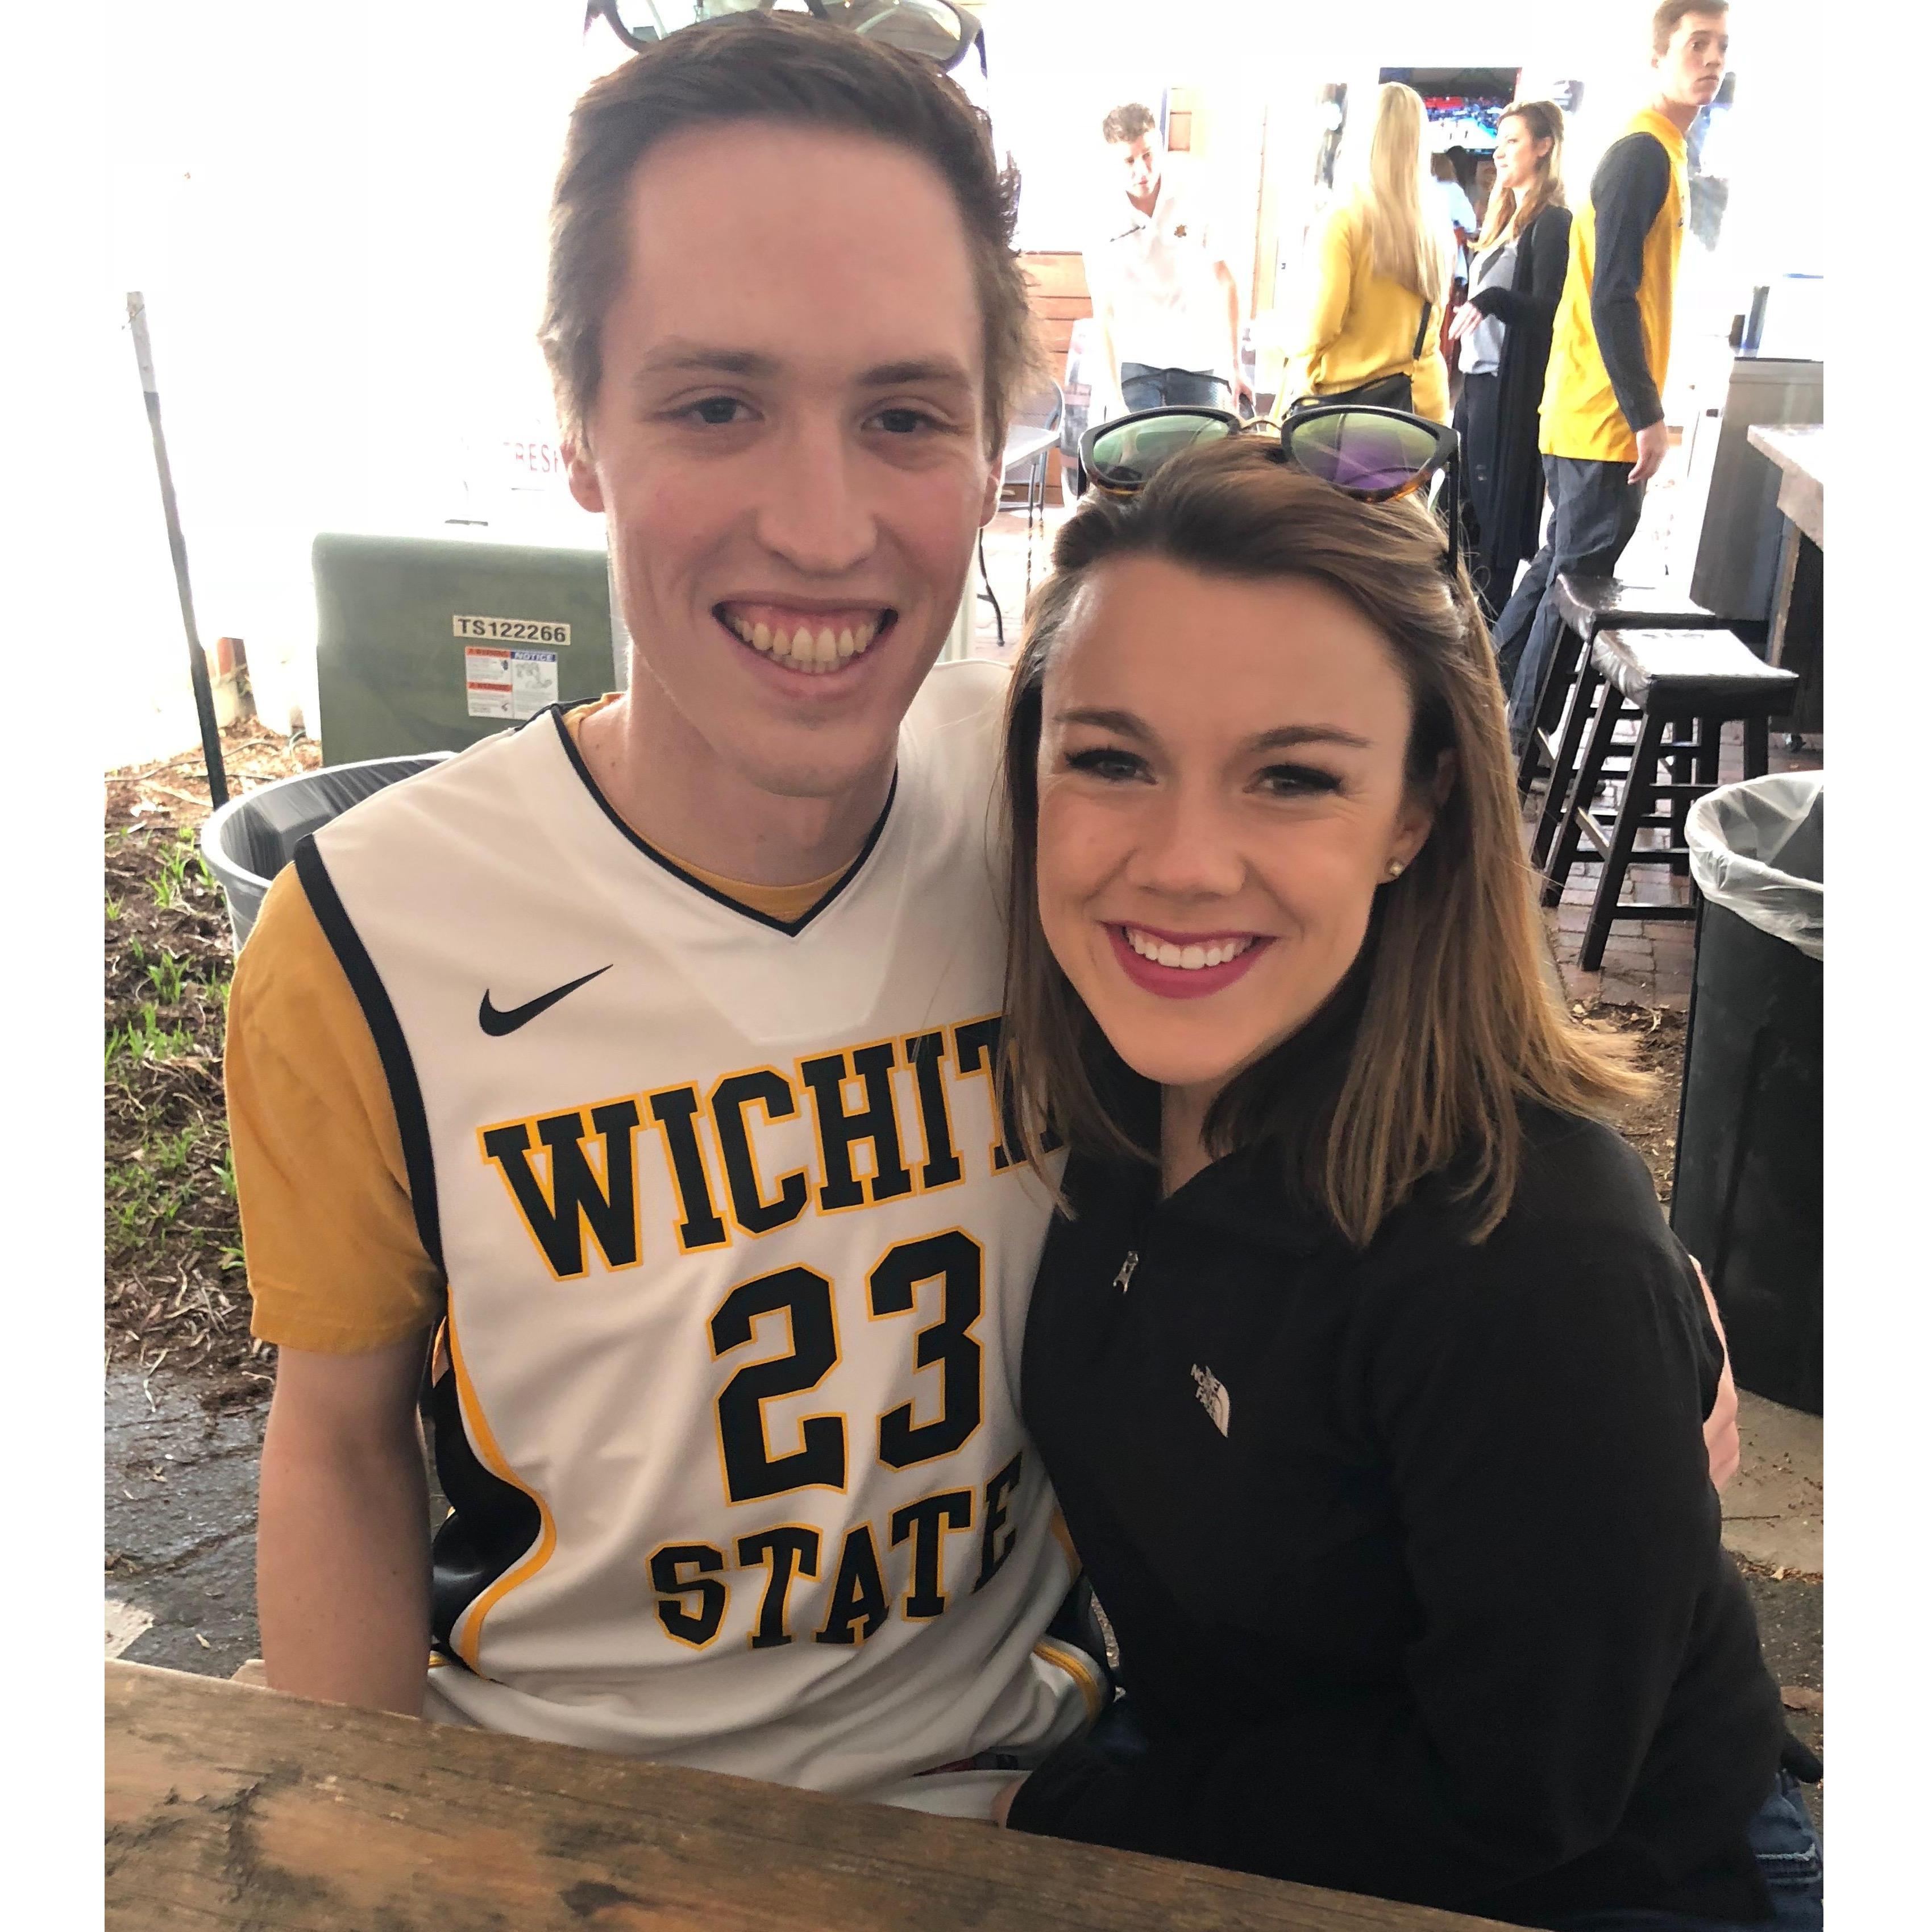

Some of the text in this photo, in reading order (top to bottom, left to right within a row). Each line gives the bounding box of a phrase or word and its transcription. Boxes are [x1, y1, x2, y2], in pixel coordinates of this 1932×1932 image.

[458, 618, 566, 642] TS122266
[514, 652, 553, 662] NOTICE
[476, 1011, 1070, 1282] WICHIT
[705, 1225, 986, 1507] 23
[645, 1452, 1023, 1651] STATE
